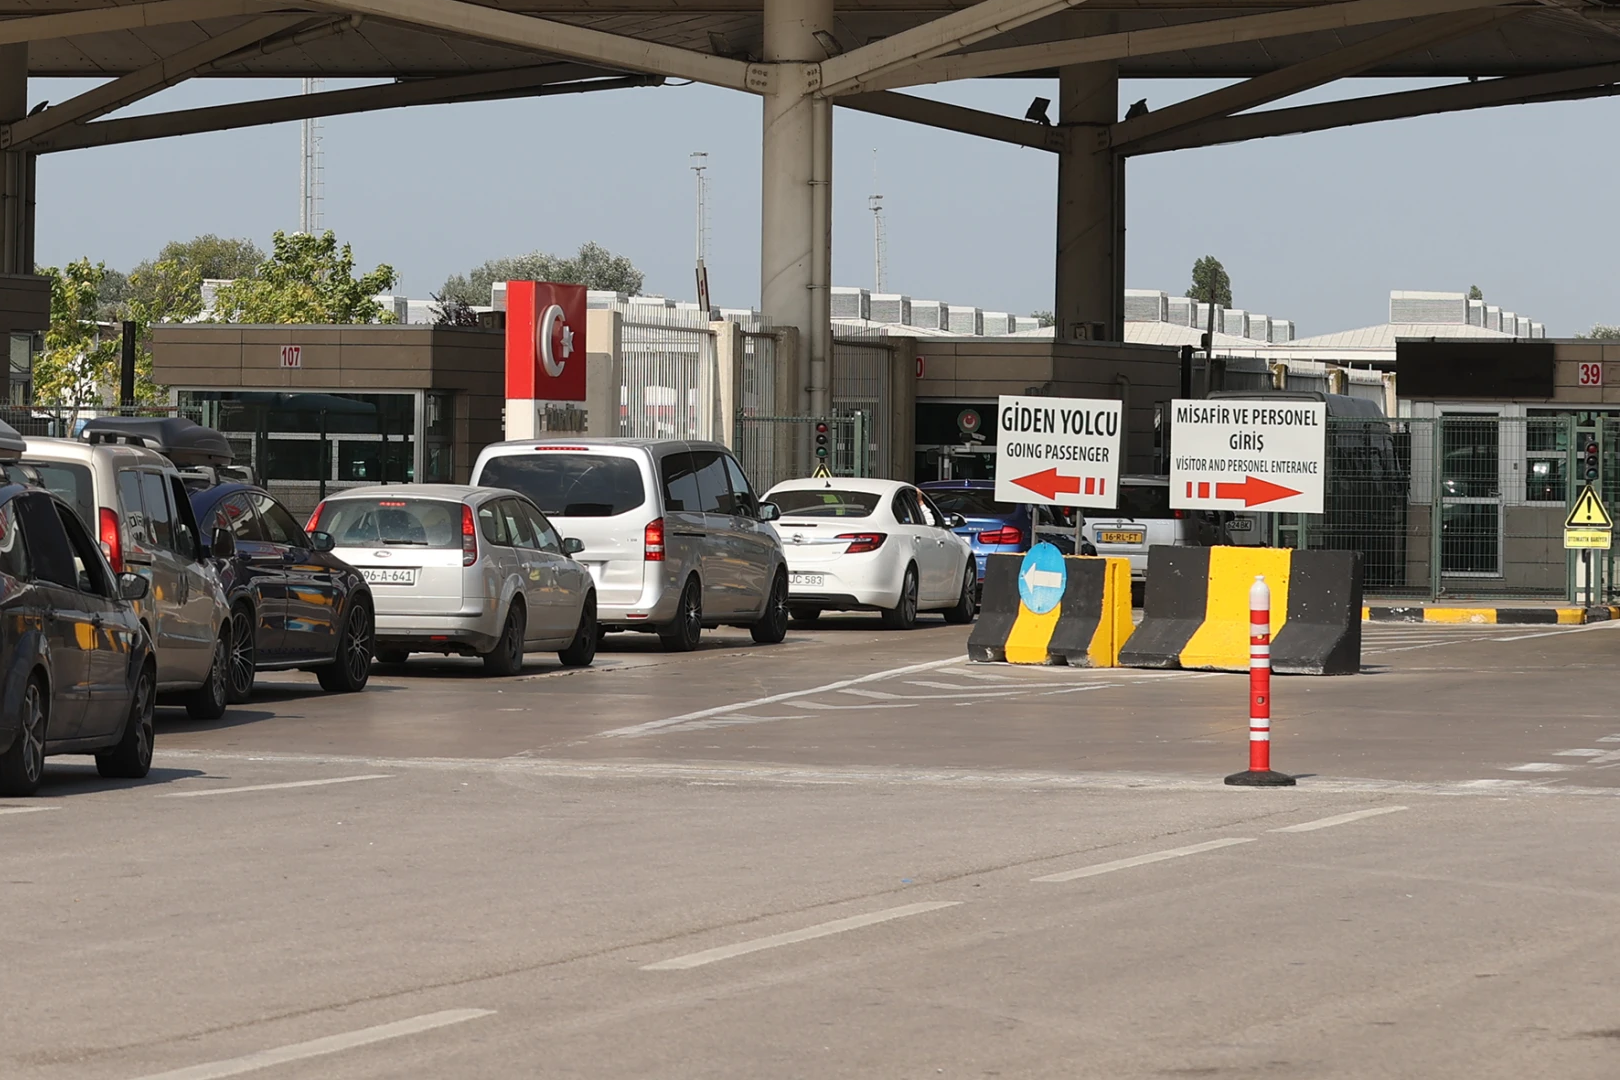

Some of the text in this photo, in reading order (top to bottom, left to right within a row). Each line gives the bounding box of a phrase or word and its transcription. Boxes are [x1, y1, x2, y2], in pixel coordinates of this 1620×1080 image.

[281, 346, 300, 366] 107
[1580, 363, 1601, 385] 39
[1001, 401, 1118, 436] GİDEN YOLCU
[1176, 404, 1318, 426] MİSAFİR VE PERSONEL
[1229, 430, 1264, 452] GİRİŞ
[1006, 442, 1109, 462] GOING PASSENGER
[1208, 458, 1226, 471] AND
[1227, 459, 1269, 473] PERSONEL
[1271, 460, 1318, 474] ENTERANCE
[361, 570, 412, 582] 96-A-641
[805, 575, 822, 585] 583
